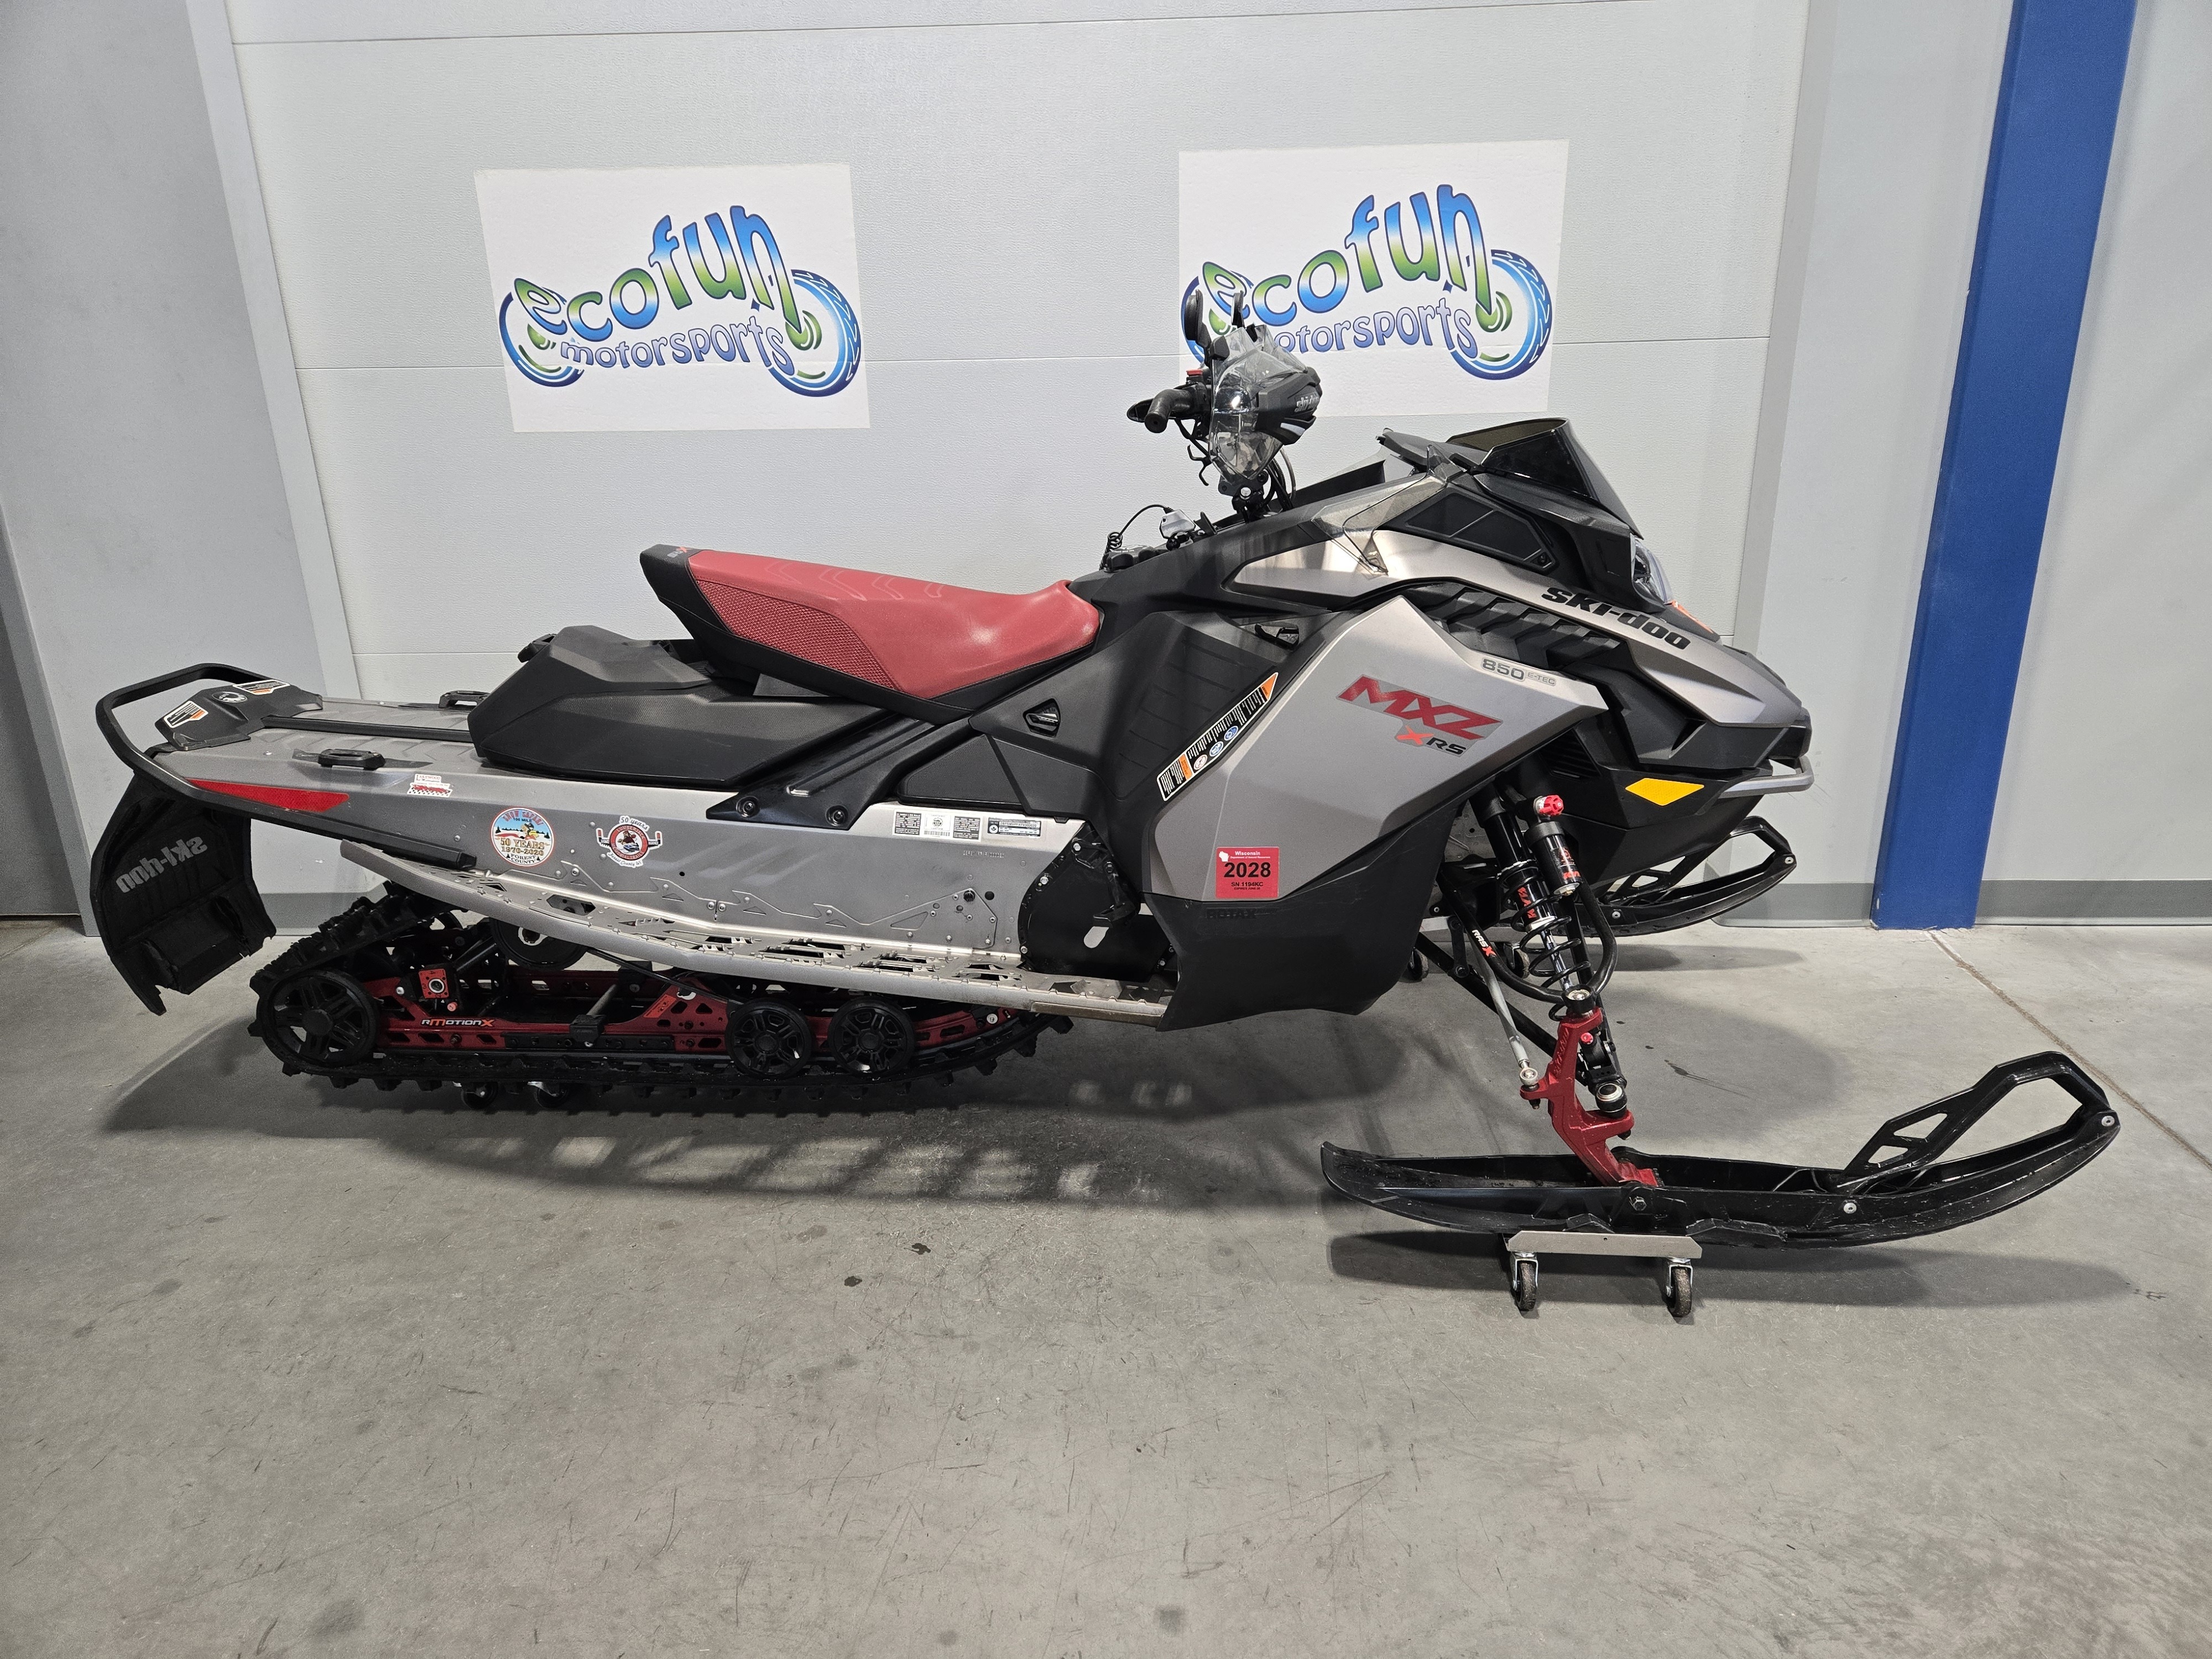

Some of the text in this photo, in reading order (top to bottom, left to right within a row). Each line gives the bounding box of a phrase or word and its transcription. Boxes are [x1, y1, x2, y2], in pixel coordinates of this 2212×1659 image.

[514, 205, 802, 342] ecofun
[1274, 298, 1478, 359] otorsports
[560, 316, 795, 377] motorsports
[1482, 658, 1556, 685] 850 E-TEC
[1338, 676, 1501, 740] MXZ
[630, 819, 648, 830] years
[500, 838, 545, 850] 50 YEARS
[501, 846, 544, 856] 1970-2020
[1224, 862, 1271, 878] 2028
